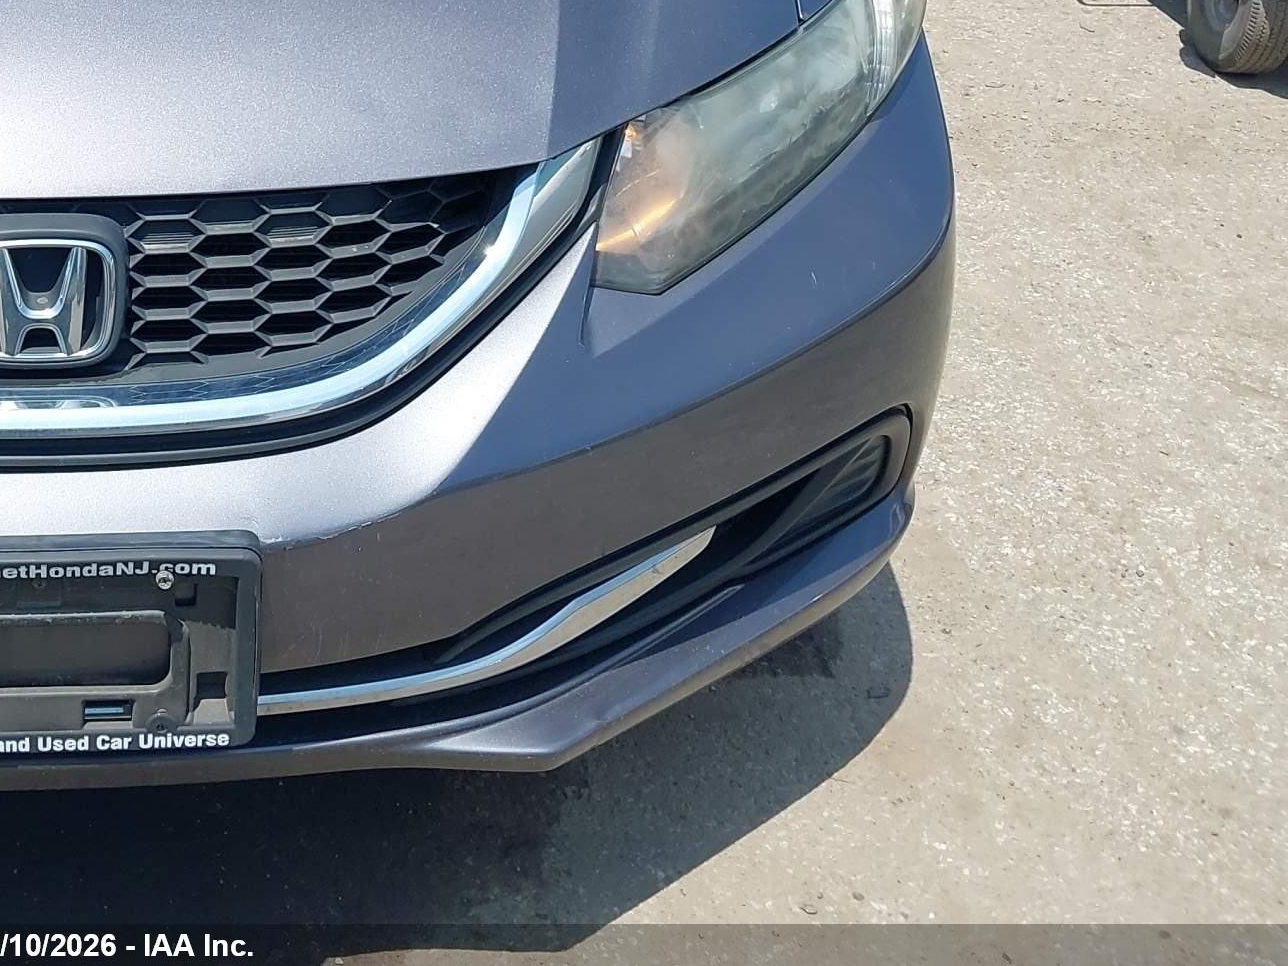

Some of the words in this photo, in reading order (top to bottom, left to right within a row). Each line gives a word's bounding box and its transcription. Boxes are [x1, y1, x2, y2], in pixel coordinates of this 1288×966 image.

[37, 736, 89, 752] Used
[96, 735, 132, 751] Car
[138, 733, 230, 749] Universe
